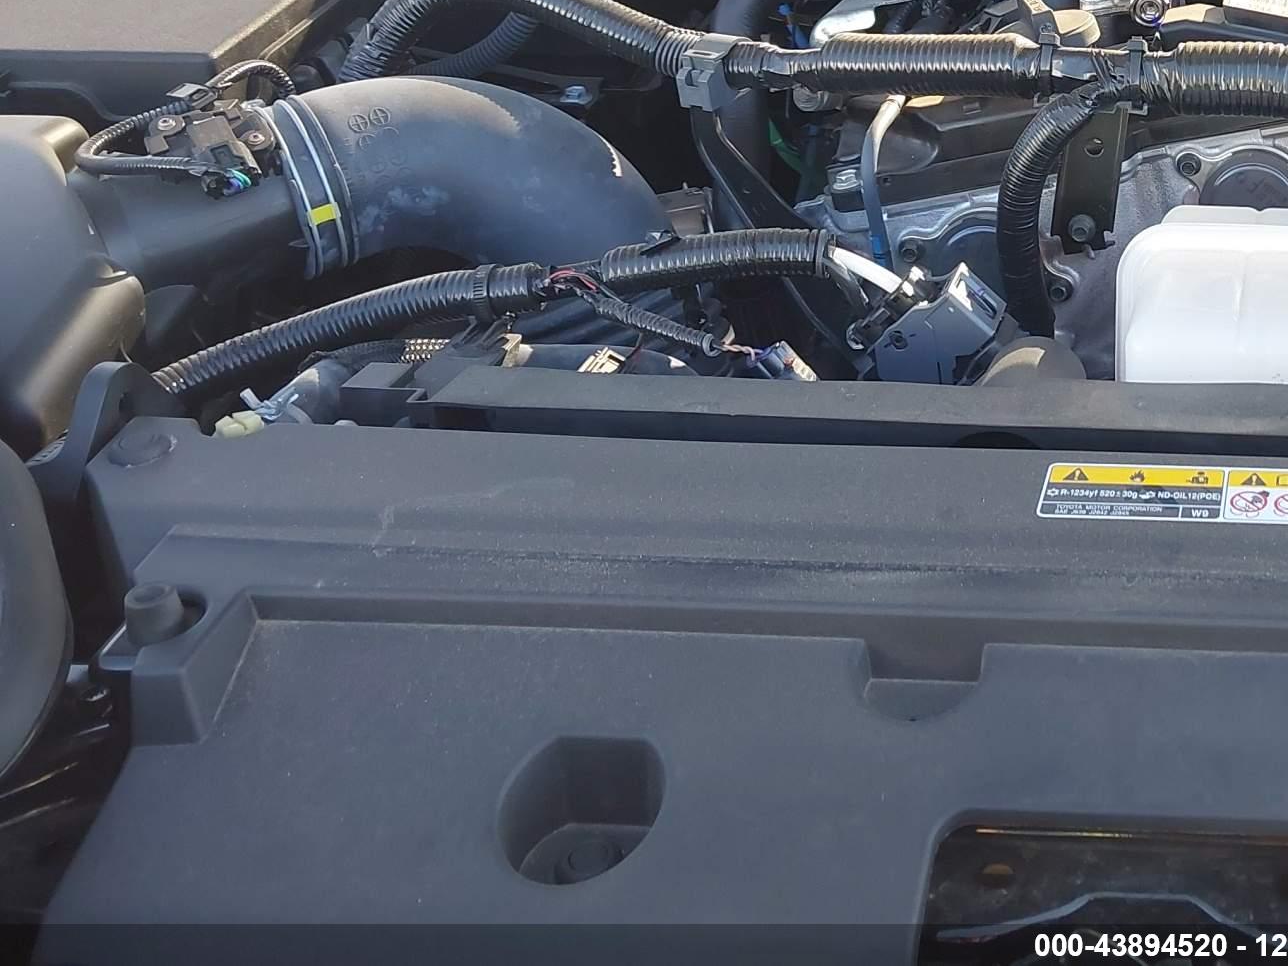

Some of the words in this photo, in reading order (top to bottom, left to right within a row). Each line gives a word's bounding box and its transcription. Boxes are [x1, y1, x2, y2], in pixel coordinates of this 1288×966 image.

[1060, 489, 1098, 498] R-1234yf
[1122, 491, 1138, 500] 30g
[1113, 505, 1162, 513] CORPORATION
